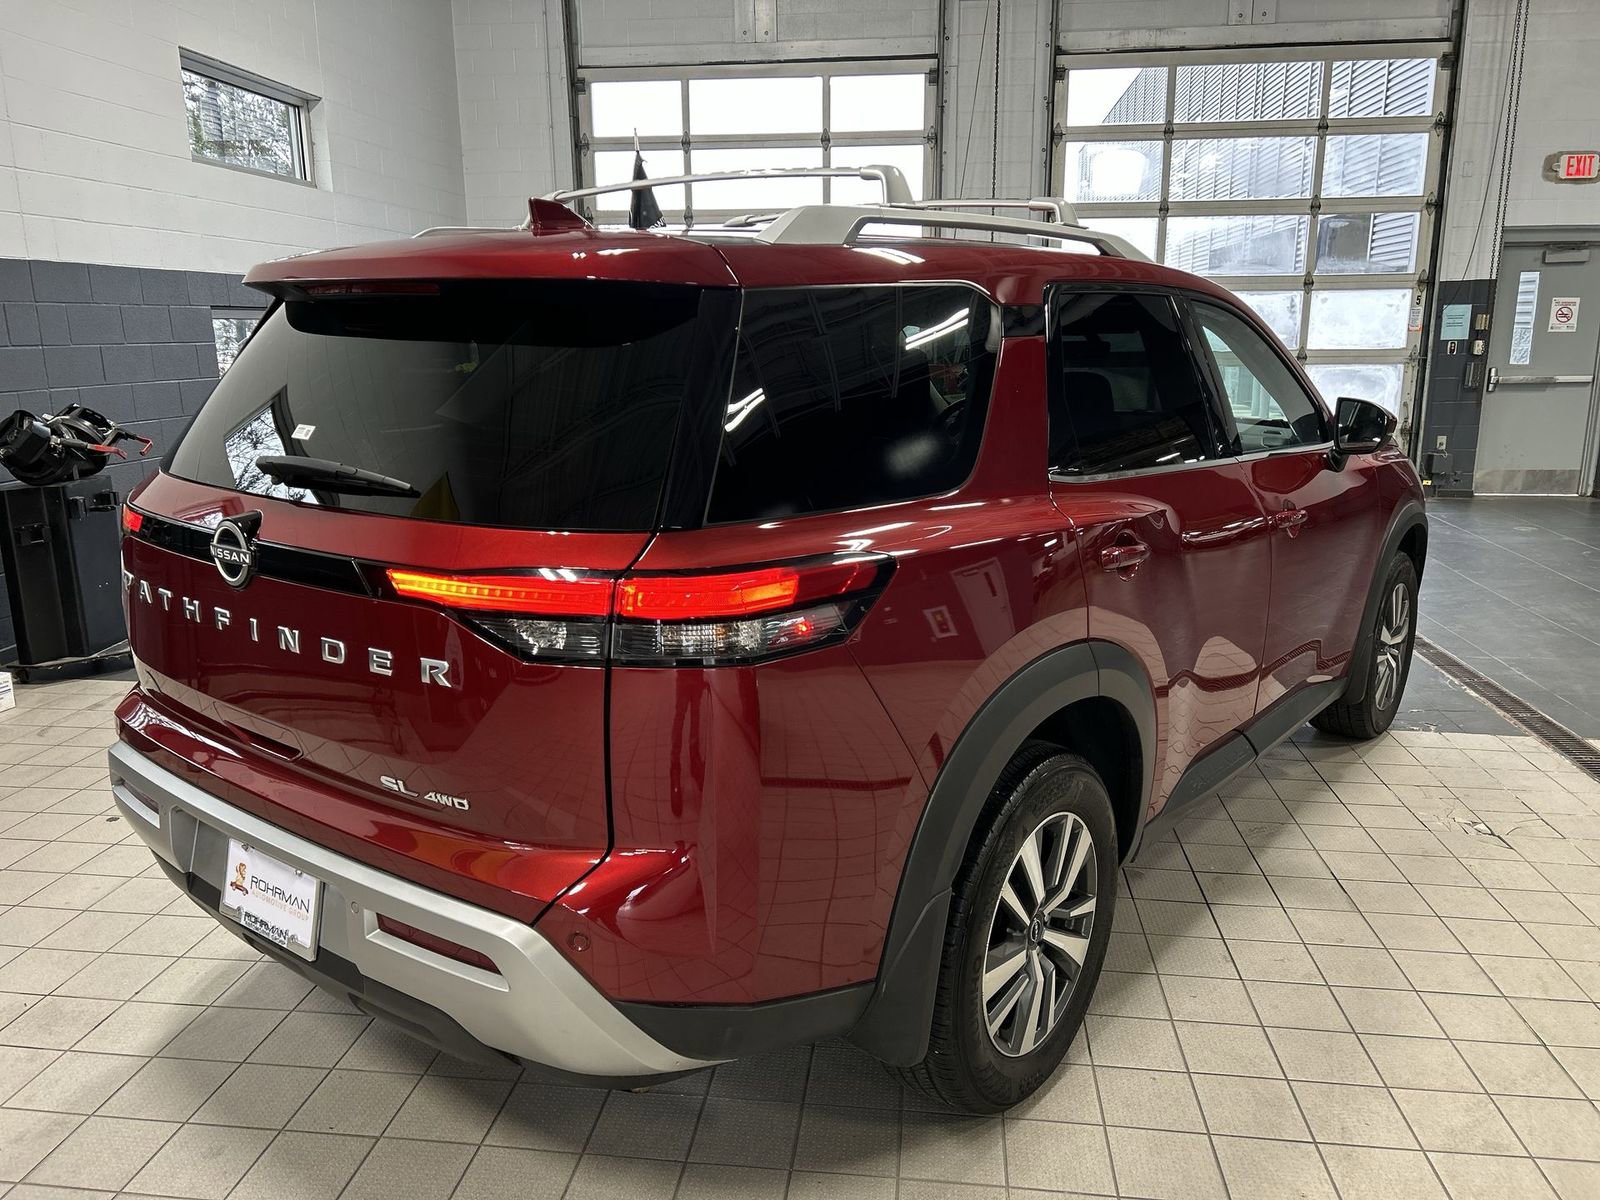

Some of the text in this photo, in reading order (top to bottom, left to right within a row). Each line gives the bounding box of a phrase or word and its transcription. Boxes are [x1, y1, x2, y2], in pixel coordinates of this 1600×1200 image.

[1566, 156, 1595, 177] EXIT
[1416, 295, 1421, 305] 5
[210, 545, 250, 564] NISSAN
[123, 570, 453, 689] PATHFINDER
[380, 775, 469, 811] SL 4WD
[250, 875, 310, 914] ROHRMAN
[252, 890, 288, 913] AUTOMOTIVE
[244, 911, 287, 940] ROHRMAN
